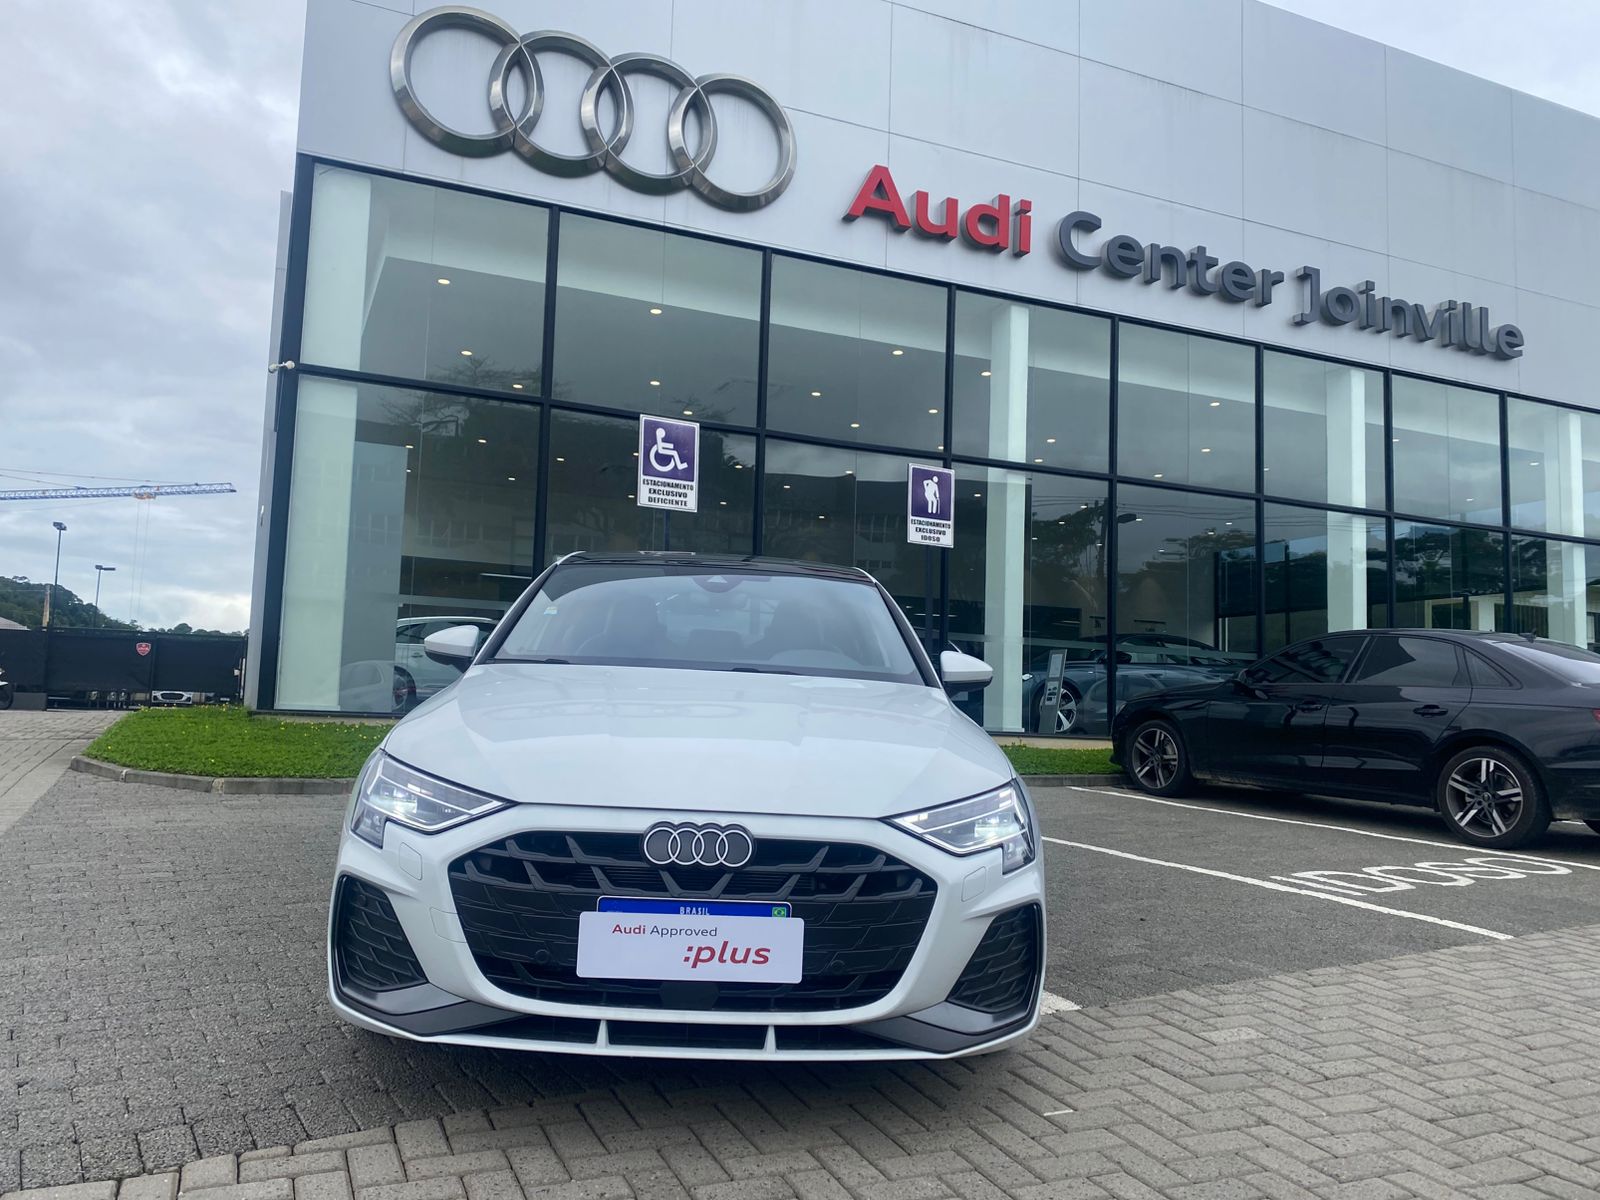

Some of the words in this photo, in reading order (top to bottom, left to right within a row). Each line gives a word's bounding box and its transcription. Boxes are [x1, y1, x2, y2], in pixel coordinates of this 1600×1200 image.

[842, 164, 1033, 257] Audi
[1057, 210, 1284, 307] Center
[1293, 265, 1524, 360] Joinville
[642, 478, 694, 491] ESTACIONAMENTO
[648, 487, 688, 499] EXCLUSIVO
[647, 496, 688, 507] DEFICIENTE
[911, 518, 951, 529] ESTACIONAMENTO
[915, 526, 947, 536] EXCLUSIVO
[920, 534, 941, 543] IDOSO
[1269, 857, 1573, 896] IDOSO
[679, 905, 710, 916] BRASIL
[612, 923, 646, 935] Audi
[649, 925, 718, 938] Approved
[683, 940, 771, 969] :plus
